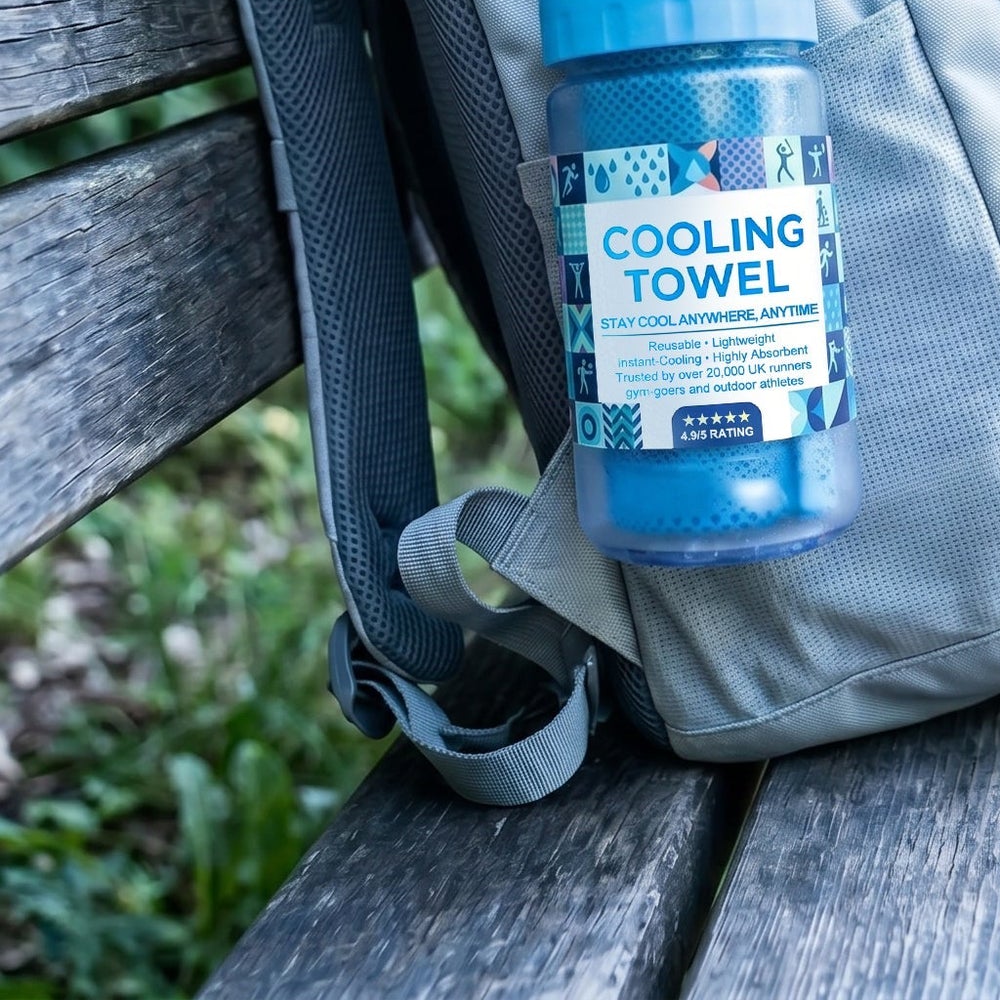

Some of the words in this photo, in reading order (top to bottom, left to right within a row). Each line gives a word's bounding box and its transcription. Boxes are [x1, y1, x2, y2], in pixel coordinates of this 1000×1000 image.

[602, 213, 804, 260] COOLING
[624, 260, 790, 302] TOWEL
[600, 316, 635, 329] STAY
[638, 314, 678, 328] COOL
[679, 308, 758, 326] ANYWHERE,
[760, 303, 819, 320] ANYTIME
[648, 339, 701, 351] Reusable
[712, 334, 775, 349] Lightweight
[713, 350, 747, 364] Highly
[751, 345, 808, 360] Absorbent
[616, 370, 658, 383] Trusted
[662, 369, 676, 383] by
[679, 370, 703, 380] over
[706, 366, 745, 379] 20,000
[748, 363, 766, 375] UK
[769, 360, 812, 373] runners
[625, 386, 686, 400] gym-goers
[689, 383, 710, 395] and
[713, 380, 756, 393] outdoor
[760, 377, 804, 389] athletes
[681, 428, 707, 441] 4.9/5
[709, 426, 754, 439] RATING
